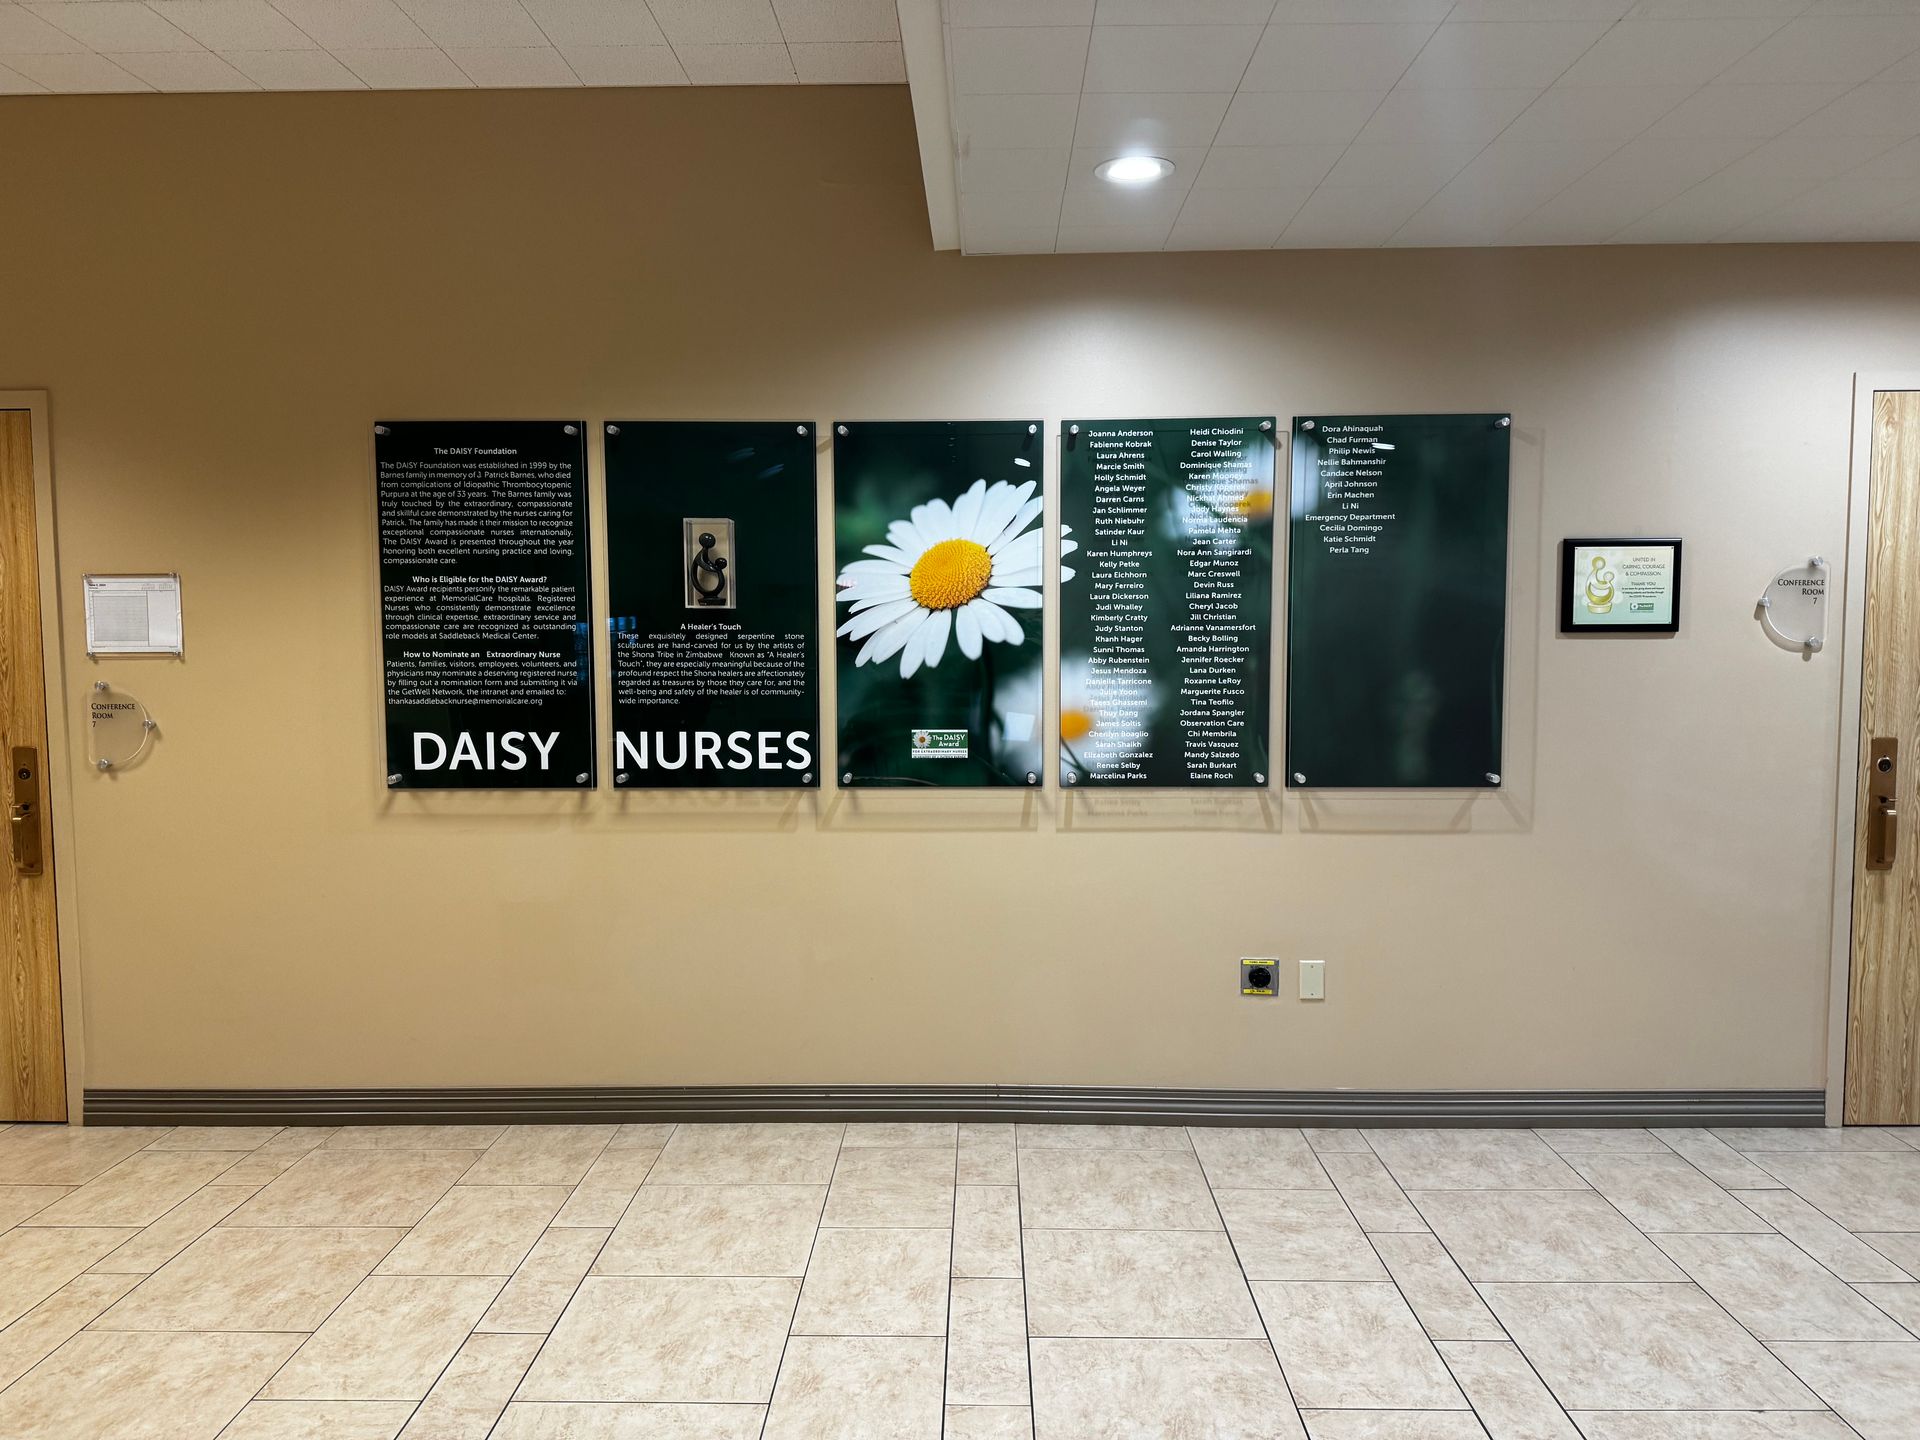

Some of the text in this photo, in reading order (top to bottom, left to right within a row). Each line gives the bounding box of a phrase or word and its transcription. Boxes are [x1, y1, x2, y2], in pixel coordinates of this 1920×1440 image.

[1218, 439, 1242, 447] Taylor
[450, 447, 472, 455] DAISY
[1094, 474, 1114, 482] Holly
[401, 481, 452, 489] complications
[463, 481, 500, 489] Idiopathic
[502, 481, 572, 490] Thrombocytopenic
[1094, 485, 1146, 493] Angela Weyer
[1305, 514, 1348, 522] Emergency
[520, 529, 573, 537] internationally.
[1110, 550, 1152, 558] Humphreys
[1350, 546, 1369, 554] Tang
[1099, 561, 1117, 569] Kelly
[1190, 560, 1211, 568] Edgar
[439, 576, 467, 584] Eligible
[1813, 597, 1818, 605] 7
[436, 604, 480, 612] consistently
[1095, 625, 1113, 633] Judy
[1188, 635, 1238, 643] Becky Bolling
[486, 651, 537, 659] Extraordinary
[1218, 677, 1241, 685] LeRoy
[618, 688, 657, 696] well-being
[674, 688, 695, 696] safety
[388, 698, 543, 706] thankasaddlebacknurse@memorialcare.org
[638, 697, 680, 705] importance.
[413, 731, 560, 770] DAISY
[616, 731, 811, 770] NURSES
